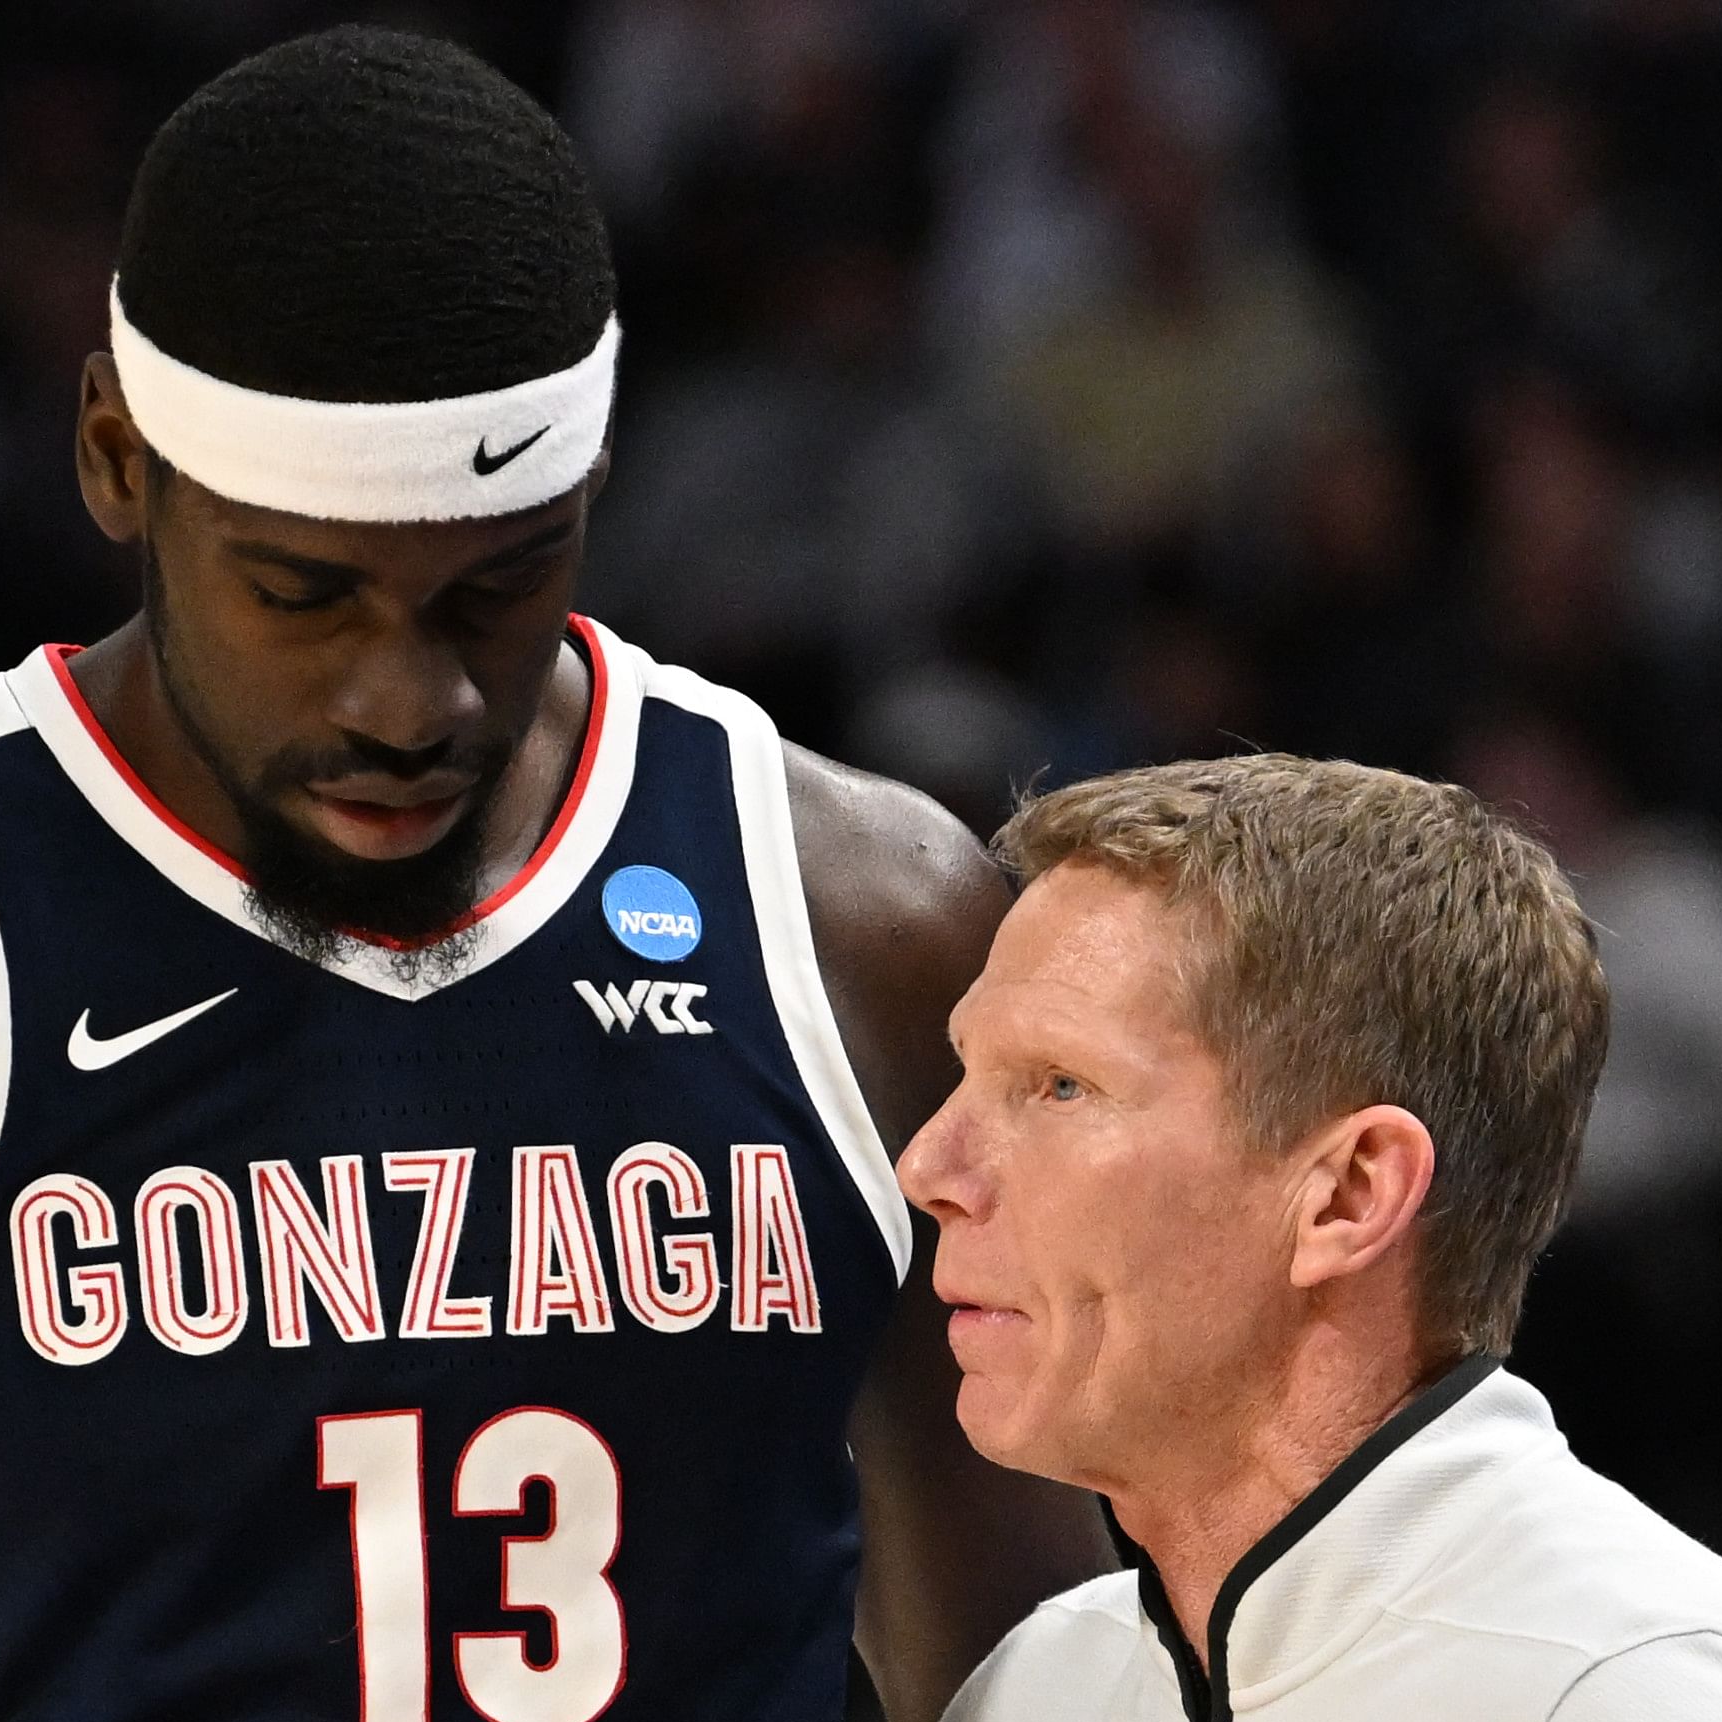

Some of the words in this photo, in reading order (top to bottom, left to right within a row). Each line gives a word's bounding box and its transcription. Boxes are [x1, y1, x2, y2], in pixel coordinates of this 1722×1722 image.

[617, 910, 697, 939] NCAA
[572, 979, 715, 1035] WCC
[9, 1141, 823, 1366] GONZAGA
